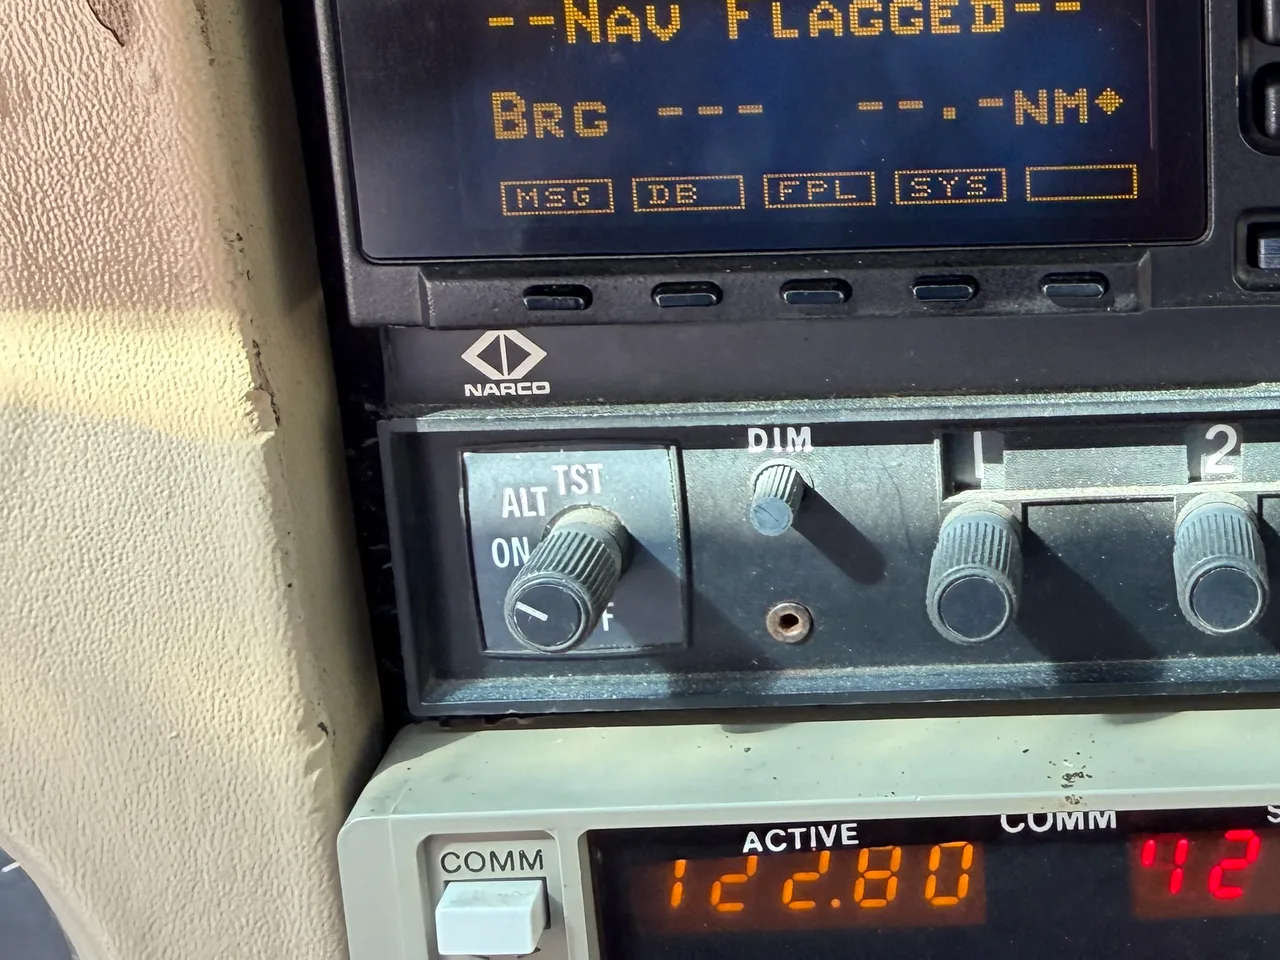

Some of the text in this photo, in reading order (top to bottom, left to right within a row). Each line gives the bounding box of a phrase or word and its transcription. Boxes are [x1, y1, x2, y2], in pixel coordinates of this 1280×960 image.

[648, 182, 699, 206] DB
[778, 178, 856, 203] FPL
[910, 173, 988, 198] SYS
[516, 187, 592, 210] MSG
[463, 382, 551, 397] NARCO
[747, 426, 813, 454] DIM
[1204, 425, 1239, 474] 2
[550, 463, 604, 496] TST
[502, 486, 549, 519] ALT
[491, 536, 531, 569] ON
[1000, 810, 1117, 834] COMM
[742, 823, 859, 854] ACTIVE
[440, 849, 544, 874] COMM
